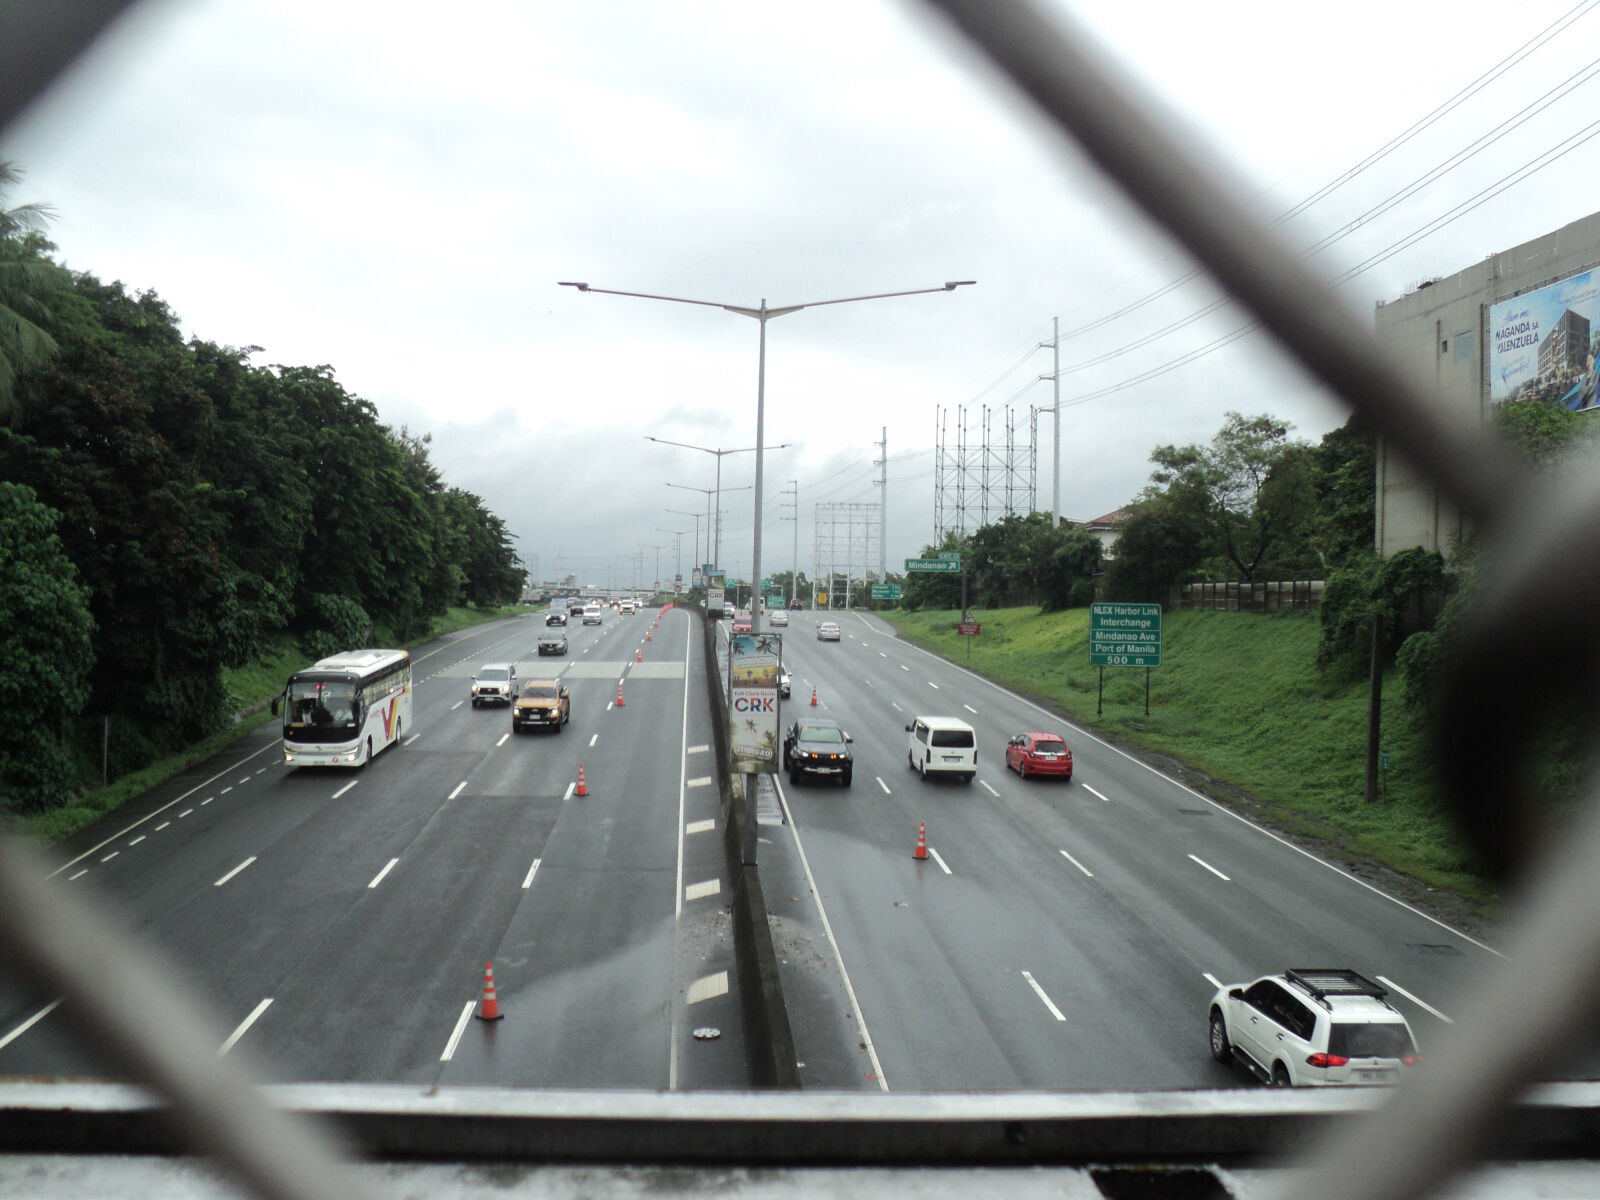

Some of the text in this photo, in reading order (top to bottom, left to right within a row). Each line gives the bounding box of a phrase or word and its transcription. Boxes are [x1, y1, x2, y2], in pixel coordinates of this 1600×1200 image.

[908, 561, 947, 570] Mindanao
[1093, 606, 1159, 616] NLEX Harbor Link
[1100, 618, 1151, 628] Interchange
[1095, 631, 1156, 641] Mindanao Ave
[1095, 643, 1156, 654] Port of Manila
[1107, 656, 1128, 665] 500
[734, 697, 775, 713] CRK
